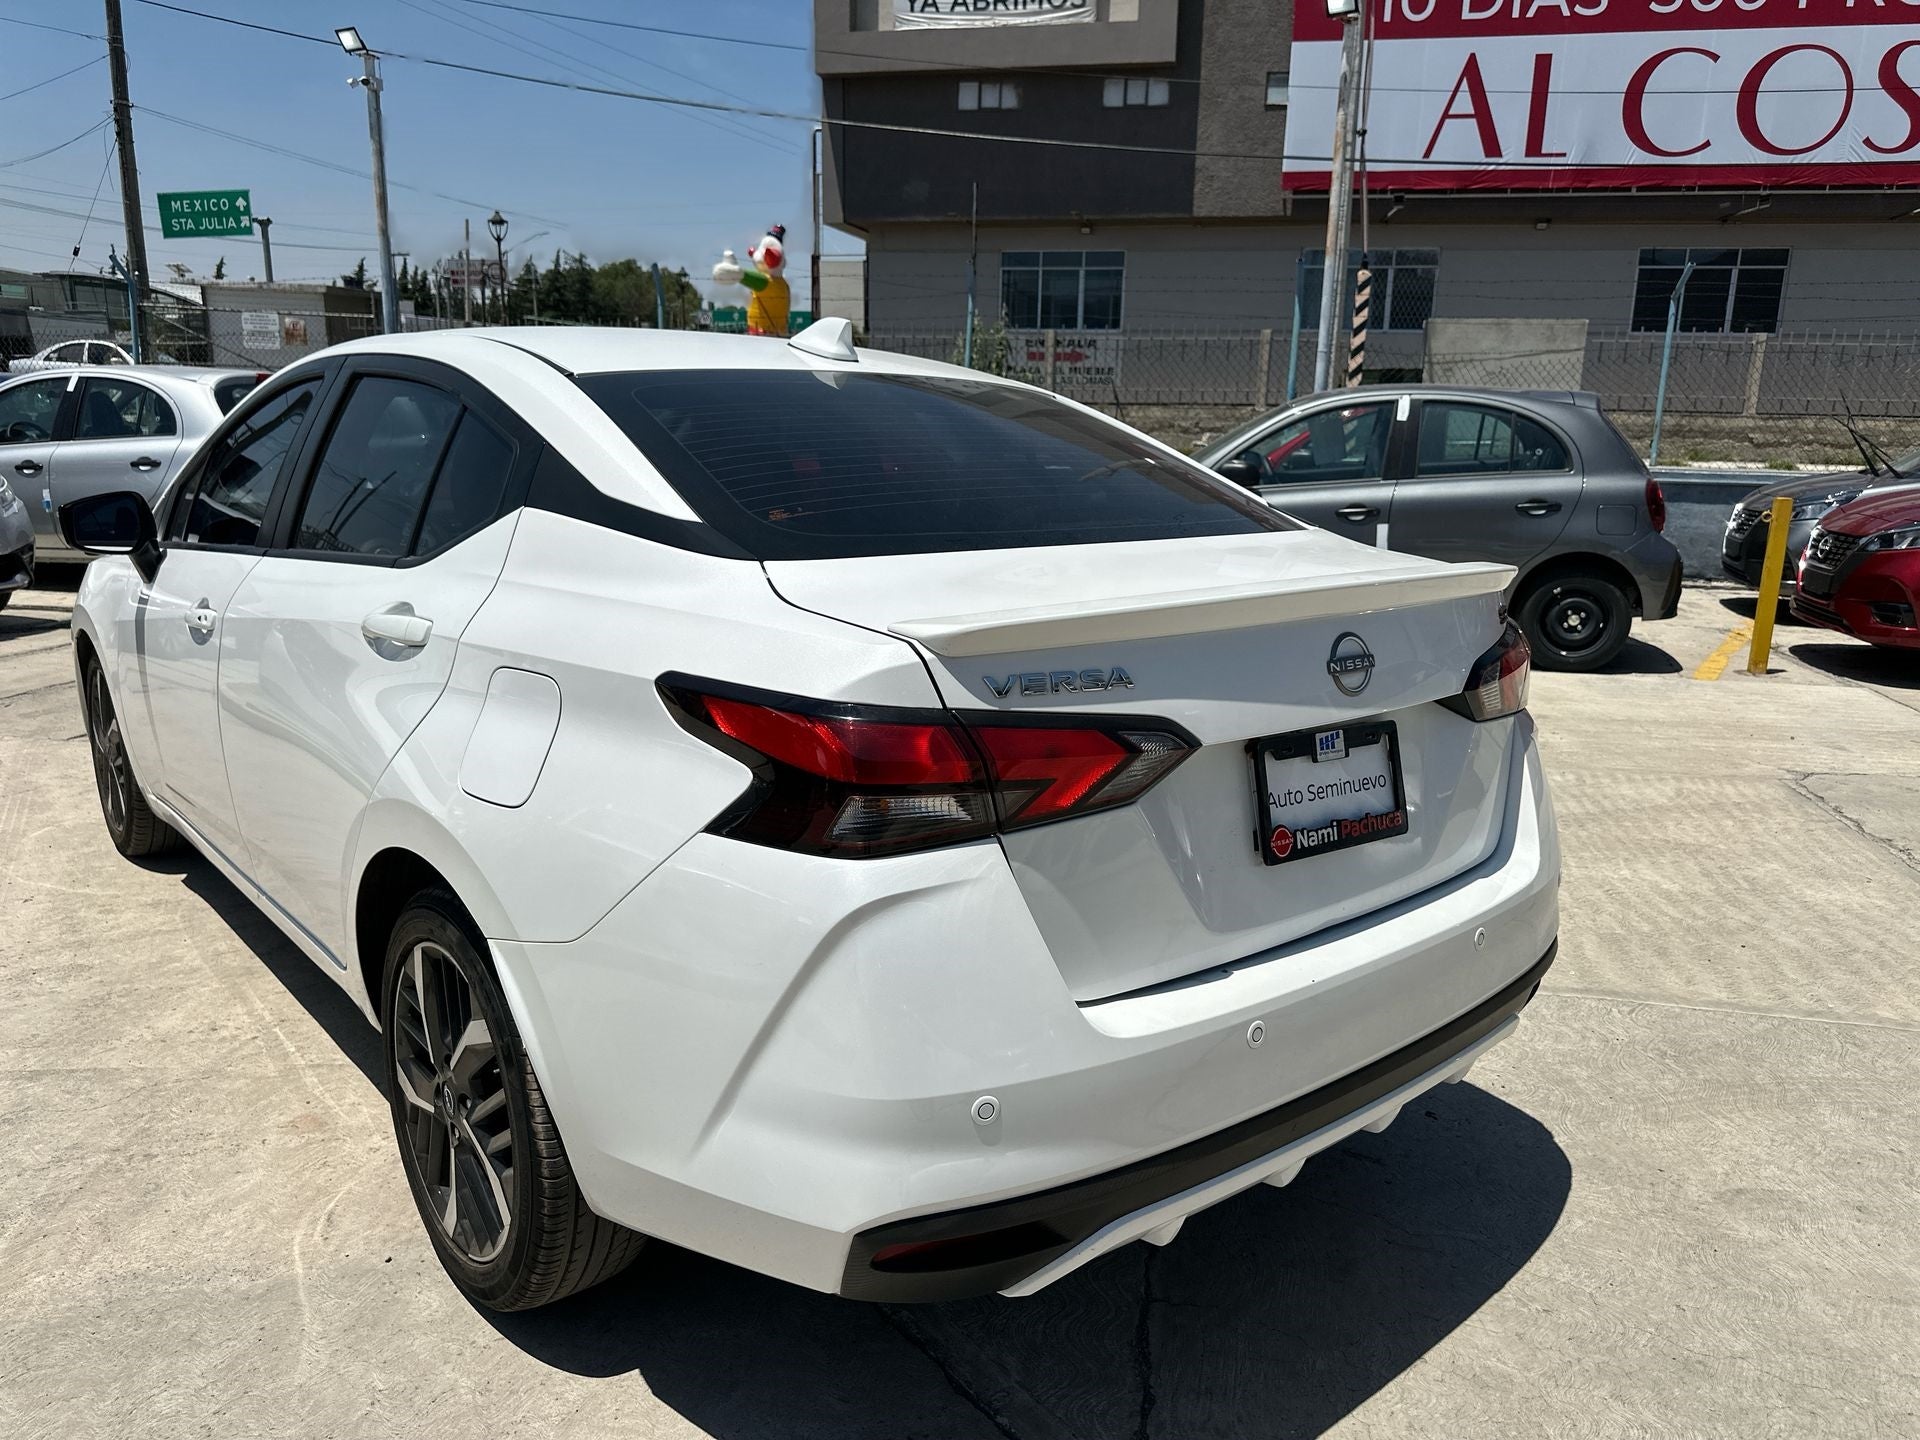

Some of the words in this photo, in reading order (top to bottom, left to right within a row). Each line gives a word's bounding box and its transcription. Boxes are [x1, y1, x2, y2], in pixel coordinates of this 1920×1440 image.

[171, 198, 229, 213] MEXICO
[171, 217, 196, 231] STA
[199, 216, 237, 230] JULIA
[1329, 656, 1375, 673] NISSAN
[983, 666, 1135, 699] VERSA
[1268, 788, 1303, 809] Auto
[1307, 774, 1387, 802] Seminuevo
[1296, 821, 1338, 849] Nami
[1341, 809, 1402, 839] Pachuca
